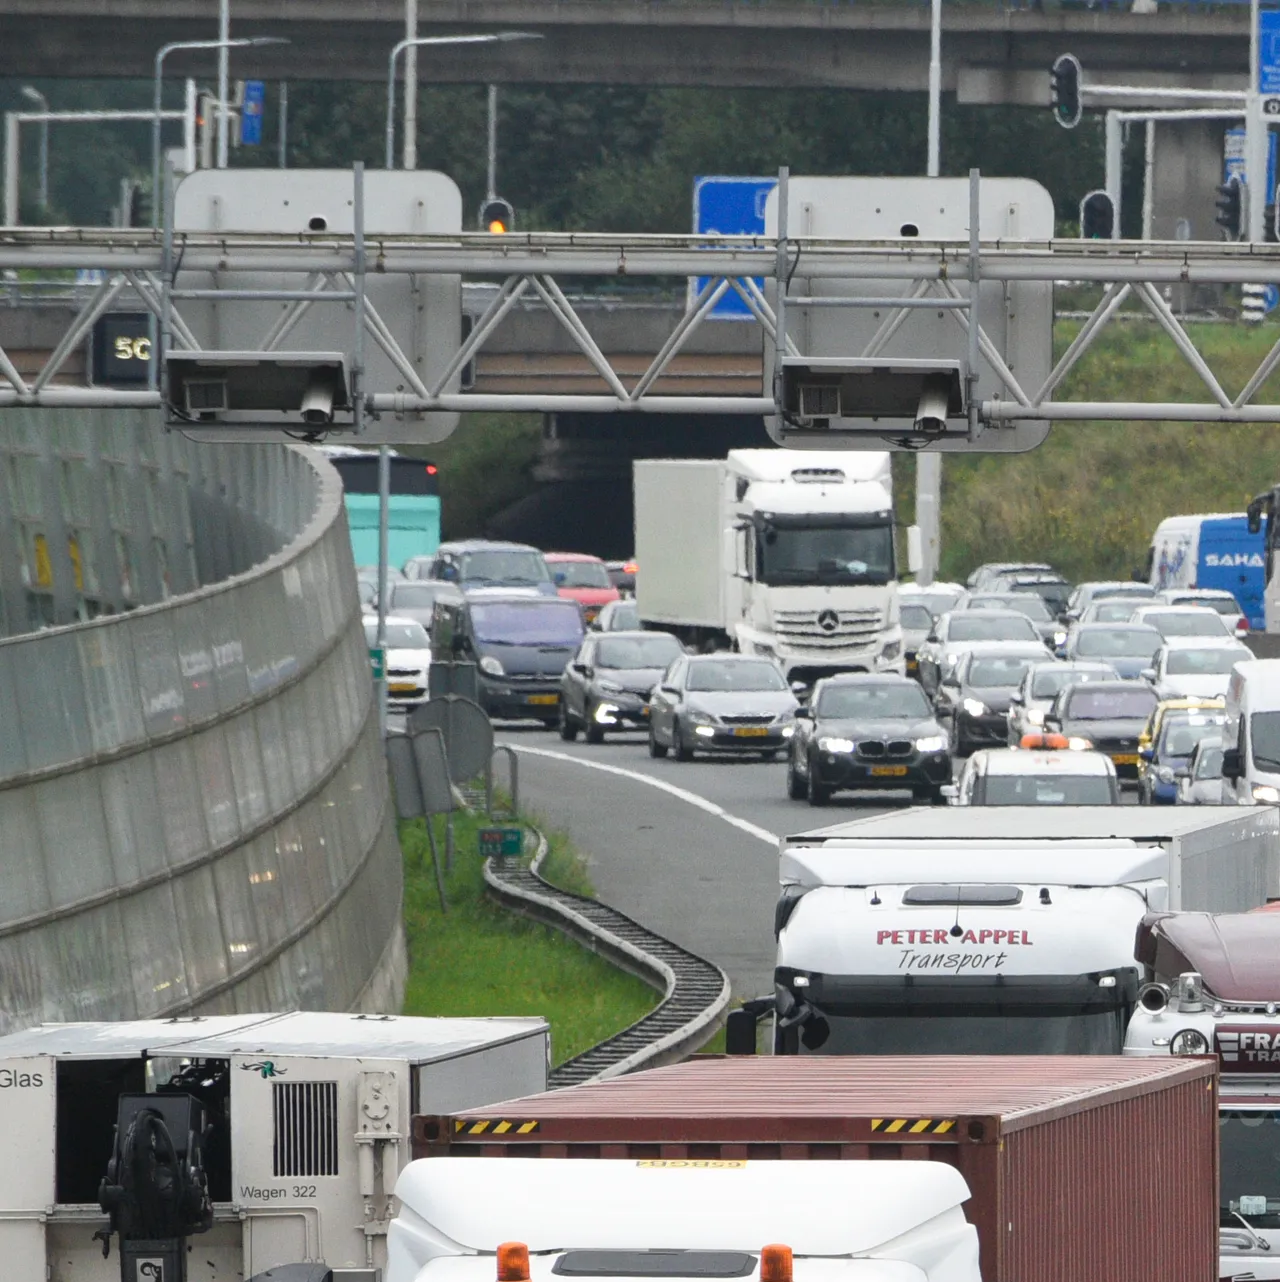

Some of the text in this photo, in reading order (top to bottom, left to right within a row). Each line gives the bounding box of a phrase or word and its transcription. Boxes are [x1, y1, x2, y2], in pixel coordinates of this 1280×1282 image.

[876, 928, 1033, 946] PETER APPEL
[897, 948, 1008, 973] Transport
[0, 1068, 43, 1089] Glas
[240, 1185, 318, 1203] Wagen 322
